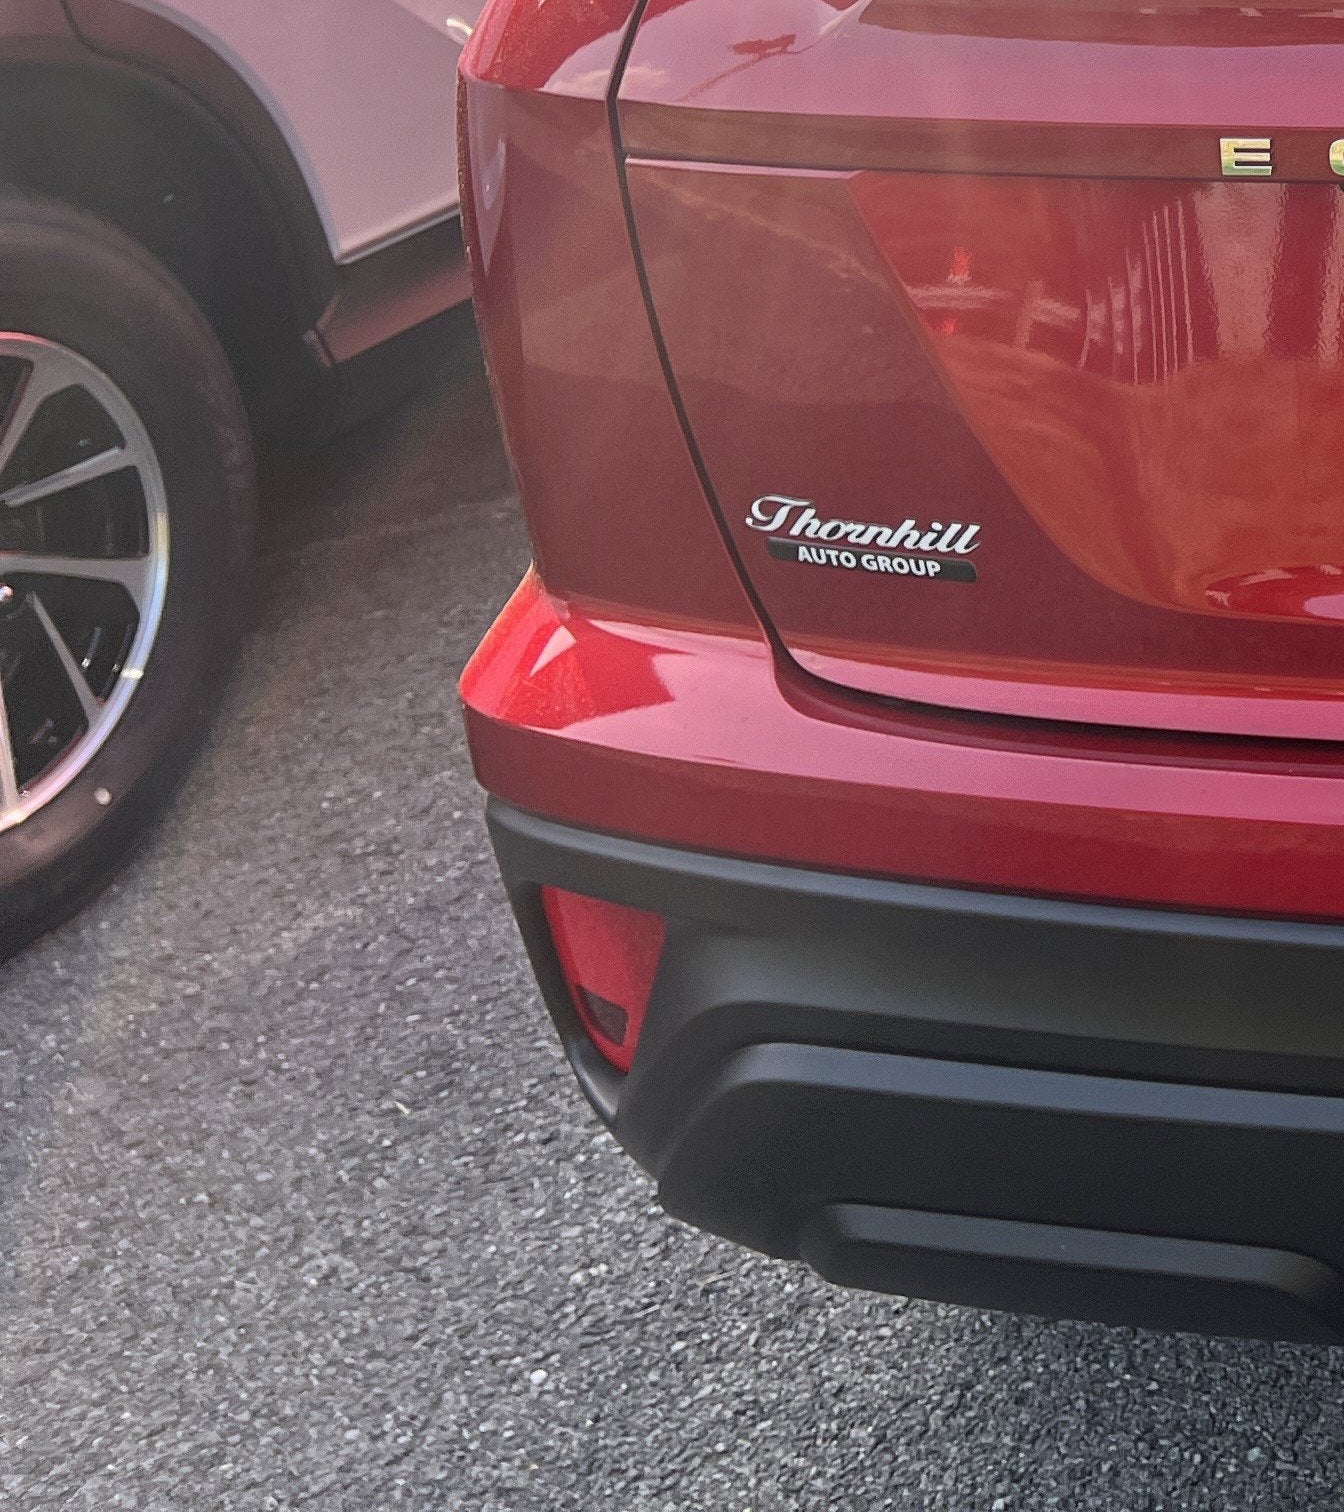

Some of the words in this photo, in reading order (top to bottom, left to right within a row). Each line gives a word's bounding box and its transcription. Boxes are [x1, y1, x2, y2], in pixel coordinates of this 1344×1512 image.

[745, 493, 981, 555] Thornhill
[797, 545, 857, 569] AUTO
[861, 553, 942, 578] GROUP
